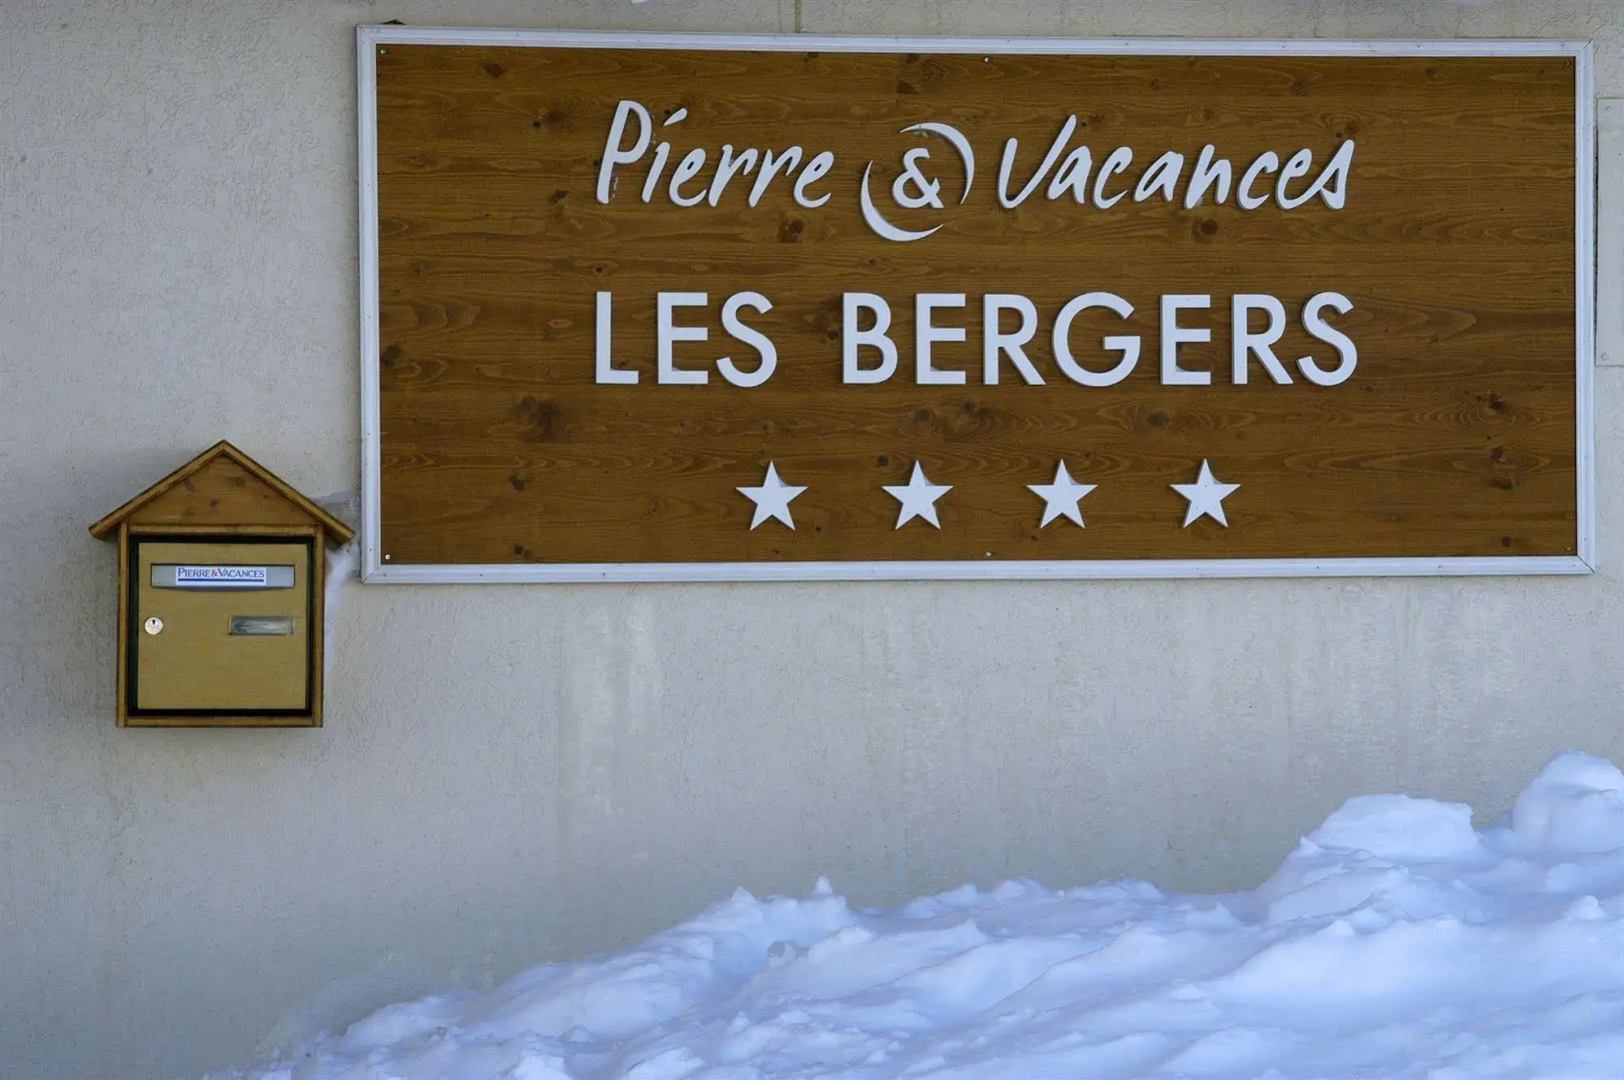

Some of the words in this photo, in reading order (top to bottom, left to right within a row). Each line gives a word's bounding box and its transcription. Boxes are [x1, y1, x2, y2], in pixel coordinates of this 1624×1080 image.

[596, 100, 835, 208] Pierre
[892, 147, 944, 209] &
[998, 114, 1355, 210] Vacances
[595, 291, 778, 388] LES
[843, 291, 1358, 388] BERGERS
